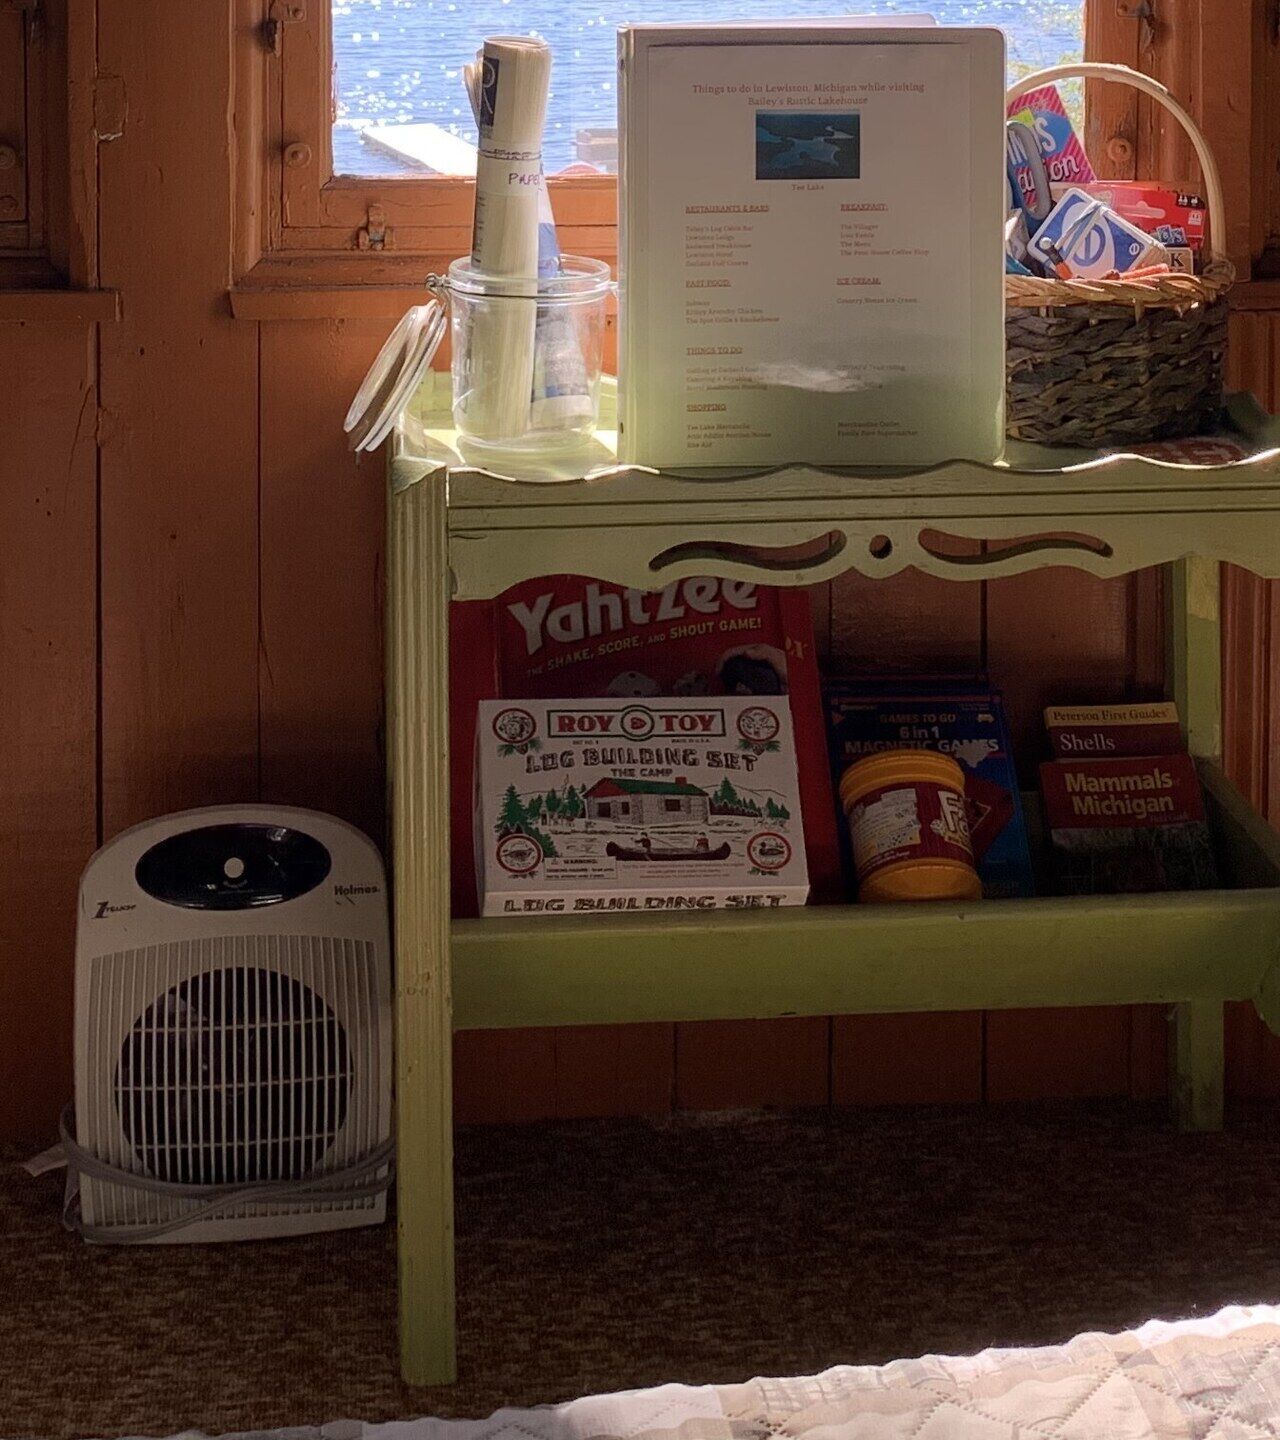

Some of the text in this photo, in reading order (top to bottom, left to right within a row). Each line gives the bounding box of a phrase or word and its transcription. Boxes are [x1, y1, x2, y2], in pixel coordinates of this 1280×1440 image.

[693, 84, 724, 95] Things
[727, 85, 736, 93] to
[739, 84, 751, 93] do
[754, 84, 762, 92] in
[814, 82, 857, 94] Michigan
[859, 82, 885, 92] while
[888, 82, 924, 93] visiting
[748, 97, 868, 107] Bailey's Rustic Lakehouse
[686, 205, 740, 214] RESTAURANTS
[687, 347, 716, 355] THINGS
[718, 346, 729, 355] TO
[687, 404, 726, 412] SHOPPING
[507, 577, 759, 656] Yahtzee
[546, 648, 594, 670] SHAKE,
[597, 635, 643, 657] SCORE,
[647, 634, 665, 644] AND
[669, 621, 715, 639] SHOUT
[718, 617, 763, 633] GAME!
[879, 713, 956, 724] GAMES TO GO
[1053, 710, 1099, 722] Peterson
[1102, 709, 1126, 720] First
[557, 714, 716, 733] ROY TOY
[899, 725, 940, 738] 6 in 1
[845, 740, 933, 754] MAGNETIC
[1060, 733, 1117, 751] Shells
[525, 747, 763, 773] LOG BUILDING SET
[611, 768, 674, 777] THE CAMP
[1065, 767, 1174, 793] Mammals
[1072, 794, 1175, 820] Michigan
[334, 884, 379, 896] Holmes
[504, 894, 786, 912] LOG BUILDING SET
